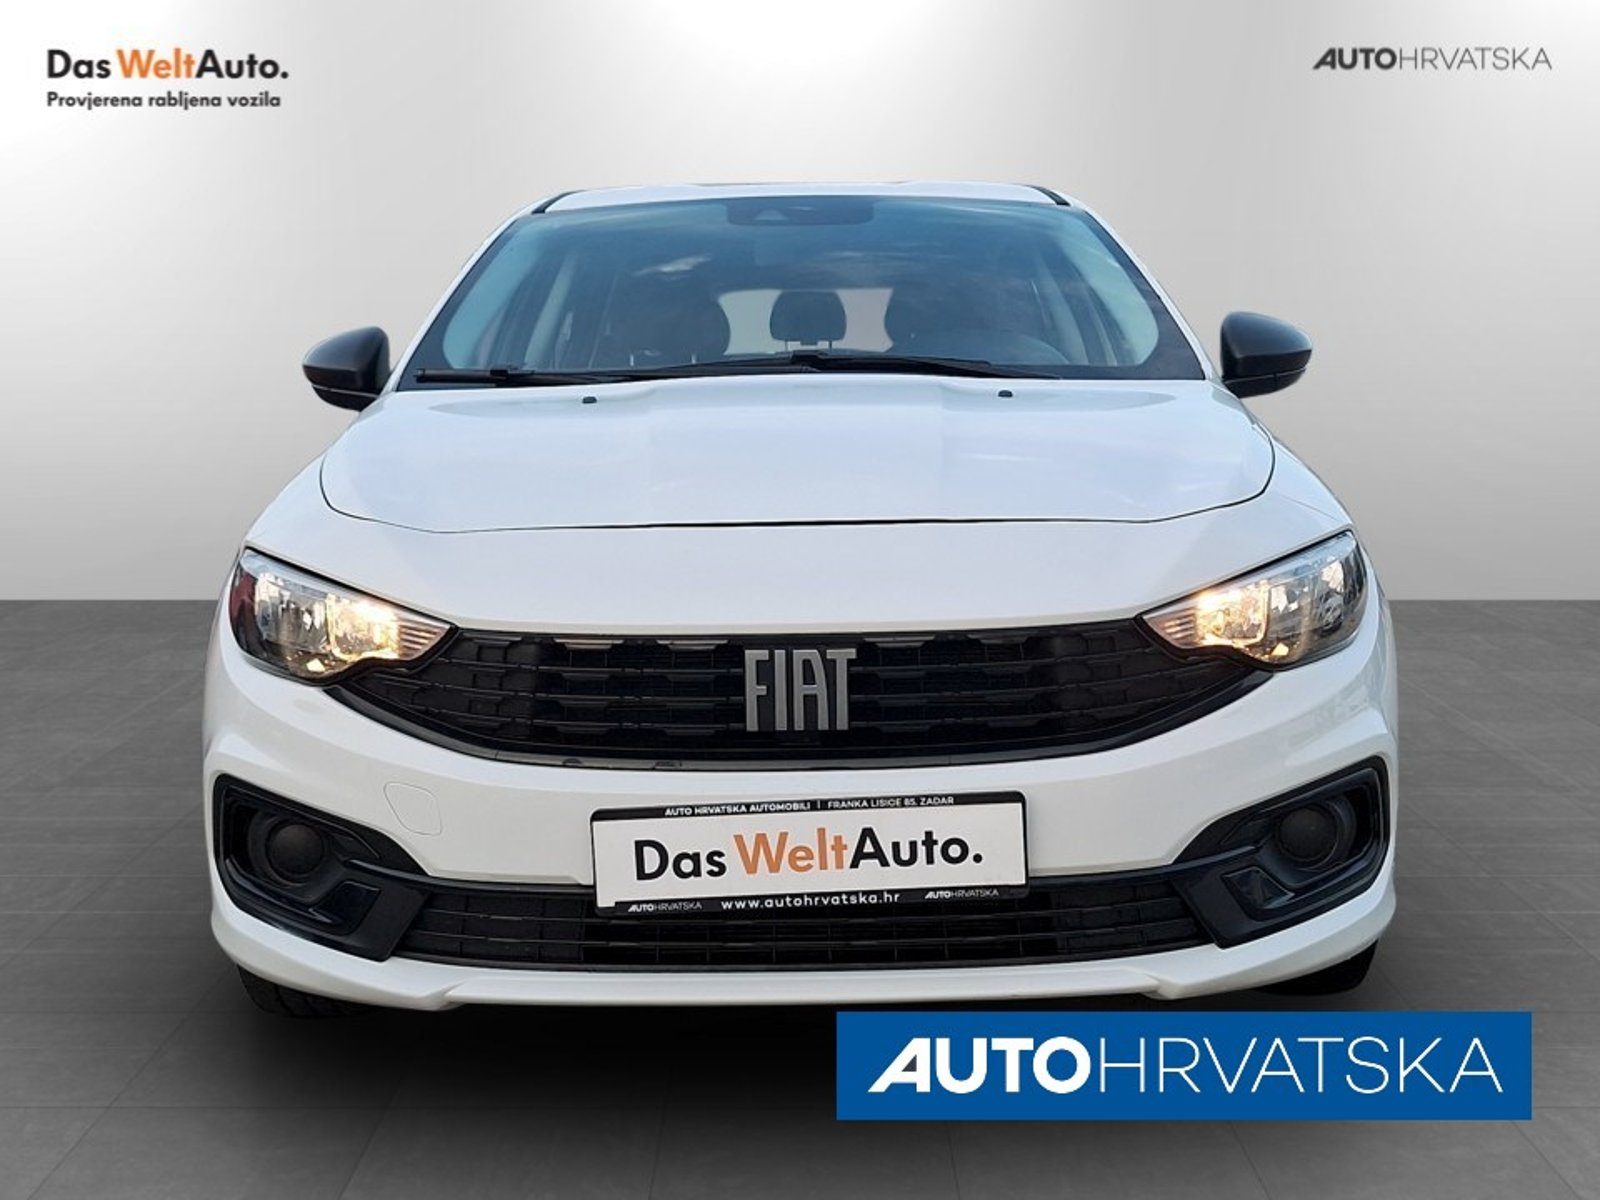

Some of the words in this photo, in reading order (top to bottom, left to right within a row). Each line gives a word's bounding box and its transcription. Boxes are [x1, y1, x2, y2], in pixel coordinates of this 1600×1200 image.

[744, 648, 858, 731] FIAT
[664, 806, 693, 816] AUTO
[694, 804, 747, 815] HRVATSKA
[749, 801, 811, 813] AUTOMOBILI
[827, 800, 869, 809] FRANKA
[919, 796, 954, 806] ZADAR
[634, 839, 727, 881] Das
[733, 826, 983, 875] WeltAuto.
[721, 891, 900, 910] www.autohrvatska.hr
[925, 887, 999, 900] AUTOHRVATSKA
[627, 901, 702, 913] AUTOHRVATSKA
